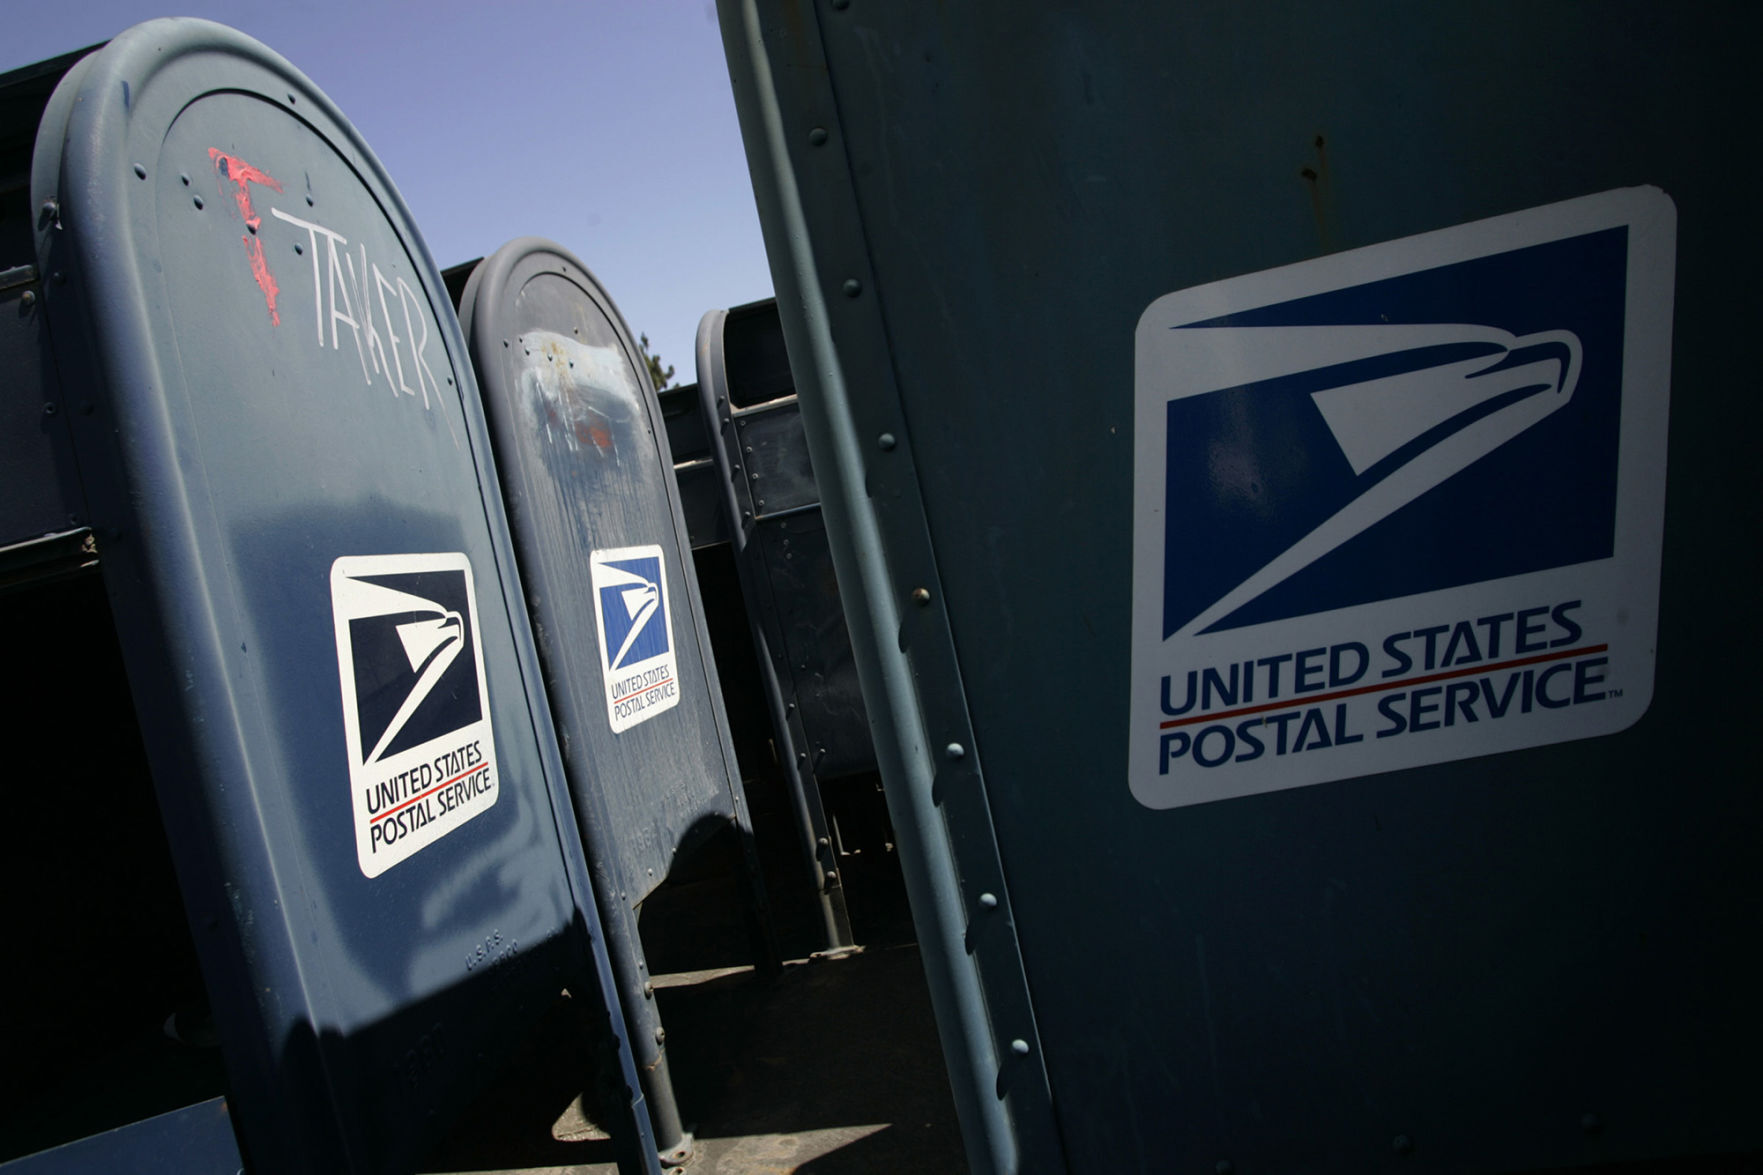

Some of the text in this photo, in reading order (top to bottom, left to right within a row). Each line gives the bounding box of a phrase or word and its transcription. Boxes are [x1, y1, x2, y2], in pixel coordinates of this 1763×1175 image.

[611, 664, 669, 699] UNITED STATES
[1160, 600, 1582, 716] UNITED STATES
[614, 682, 676, 721] POSTAL SERVICE
[1159, 703, 1364, 775] POSTAL
[1377, 657, 1609, 739] SERVICE
[366, 740, 482, 814] UNITED STATES
[370, 767, 491, 854] POSTAL SERVICE
